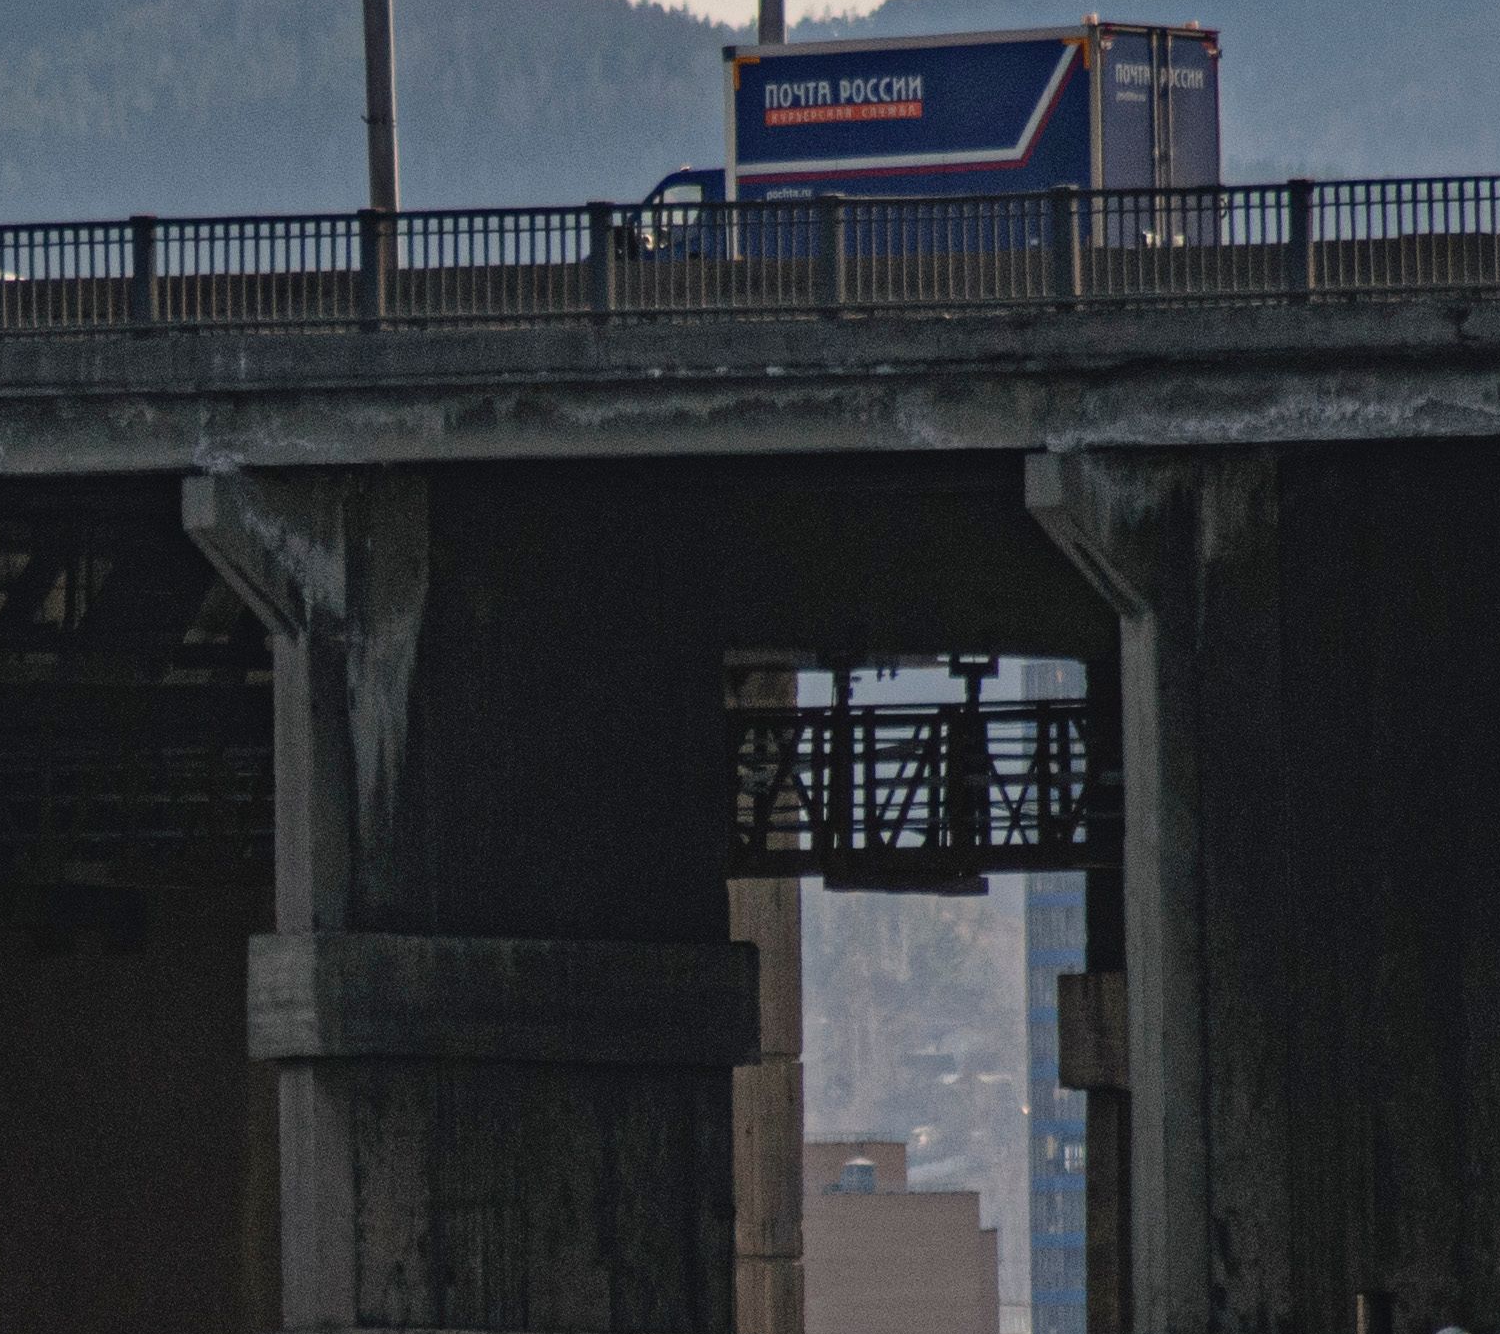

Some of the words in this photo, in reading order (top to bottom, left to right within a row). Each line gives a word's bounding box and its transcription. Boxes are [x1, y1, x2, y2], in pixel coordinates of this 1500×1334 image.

[1115, 63, 1151, 86] ПОЧТА
[765, 81, 831, 108] ПОЧТА
[839, 75, 922, 103] РОССИИ
[770, 107, 853, 124] КУРЬЕРСКАЯ
[861, 105, 917, 119] СЛУЖБА
[766, 188, 812, 202] pochta.ru
